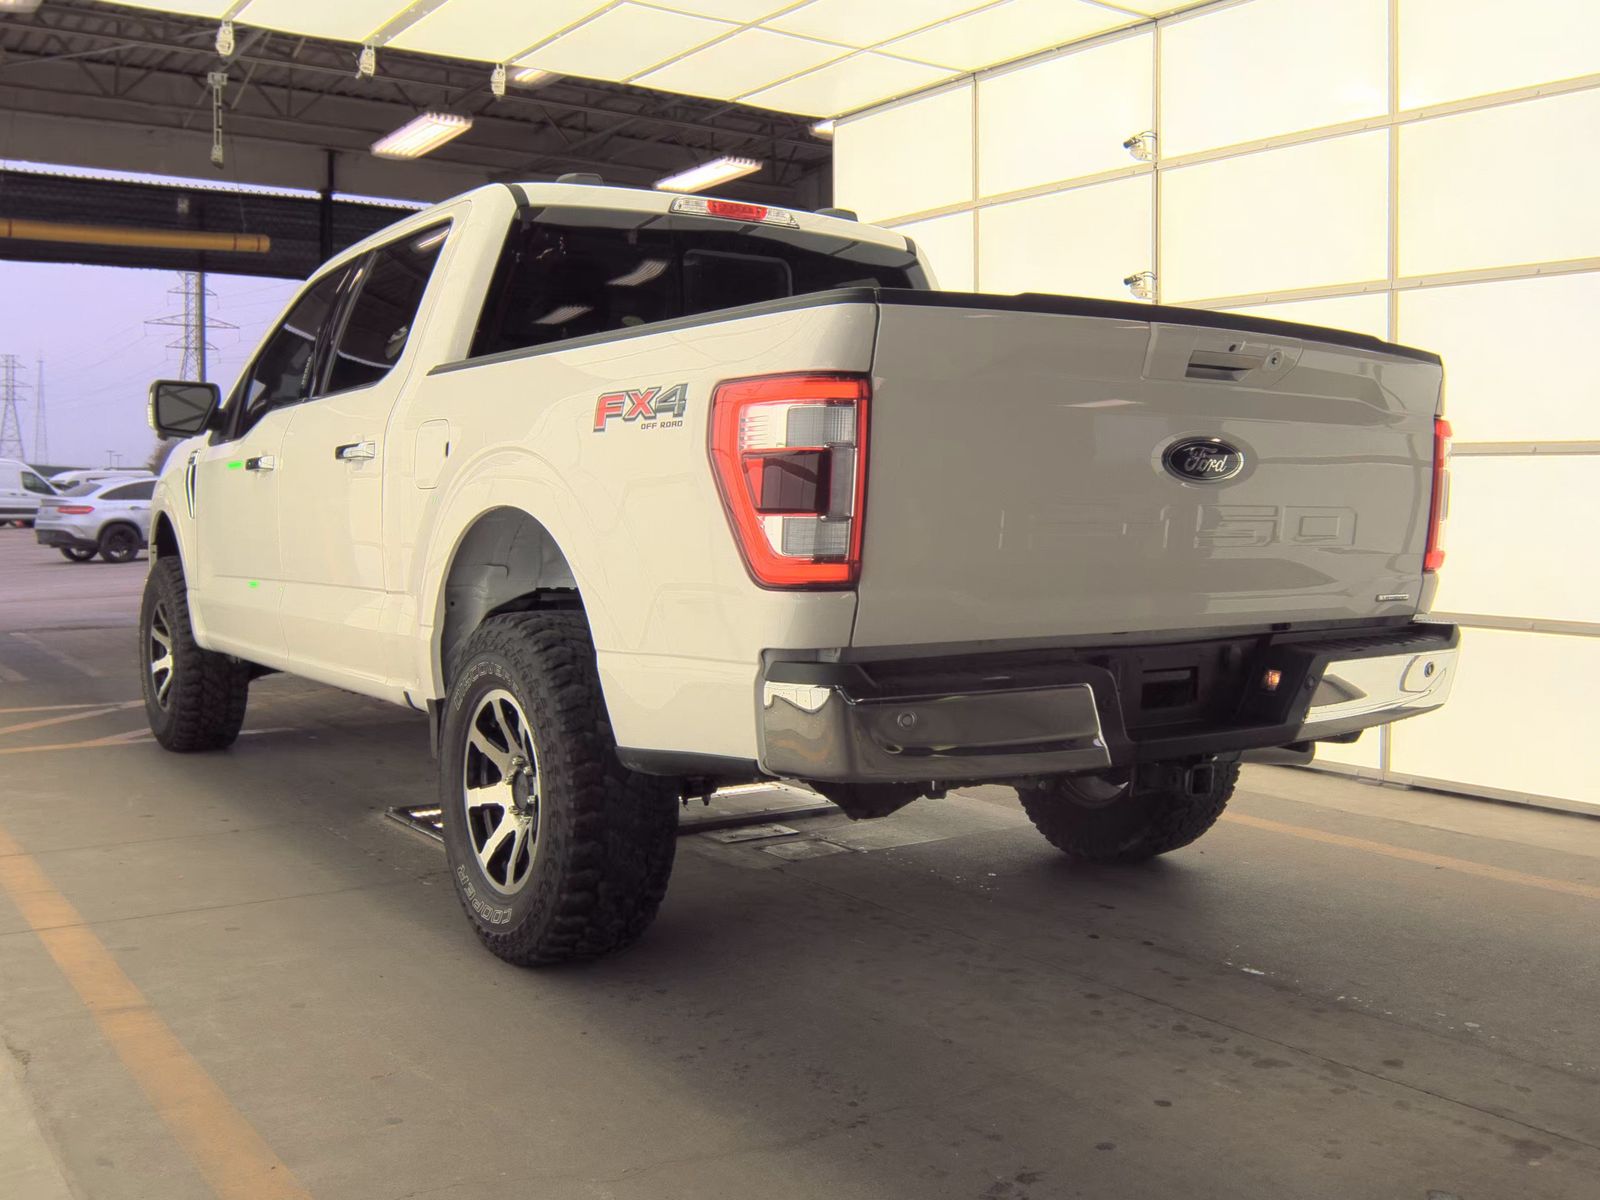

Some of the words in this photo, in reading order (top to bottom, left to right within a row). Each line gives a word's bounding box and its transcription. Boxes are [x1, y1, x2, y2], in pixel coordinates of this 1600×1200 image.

[593, 382, 688, 432] FX4
[660, 420, 683, 429] ROAD
[1183, 446, 1229, 472] Ford
[457, 864, 512, 924] COOPER
